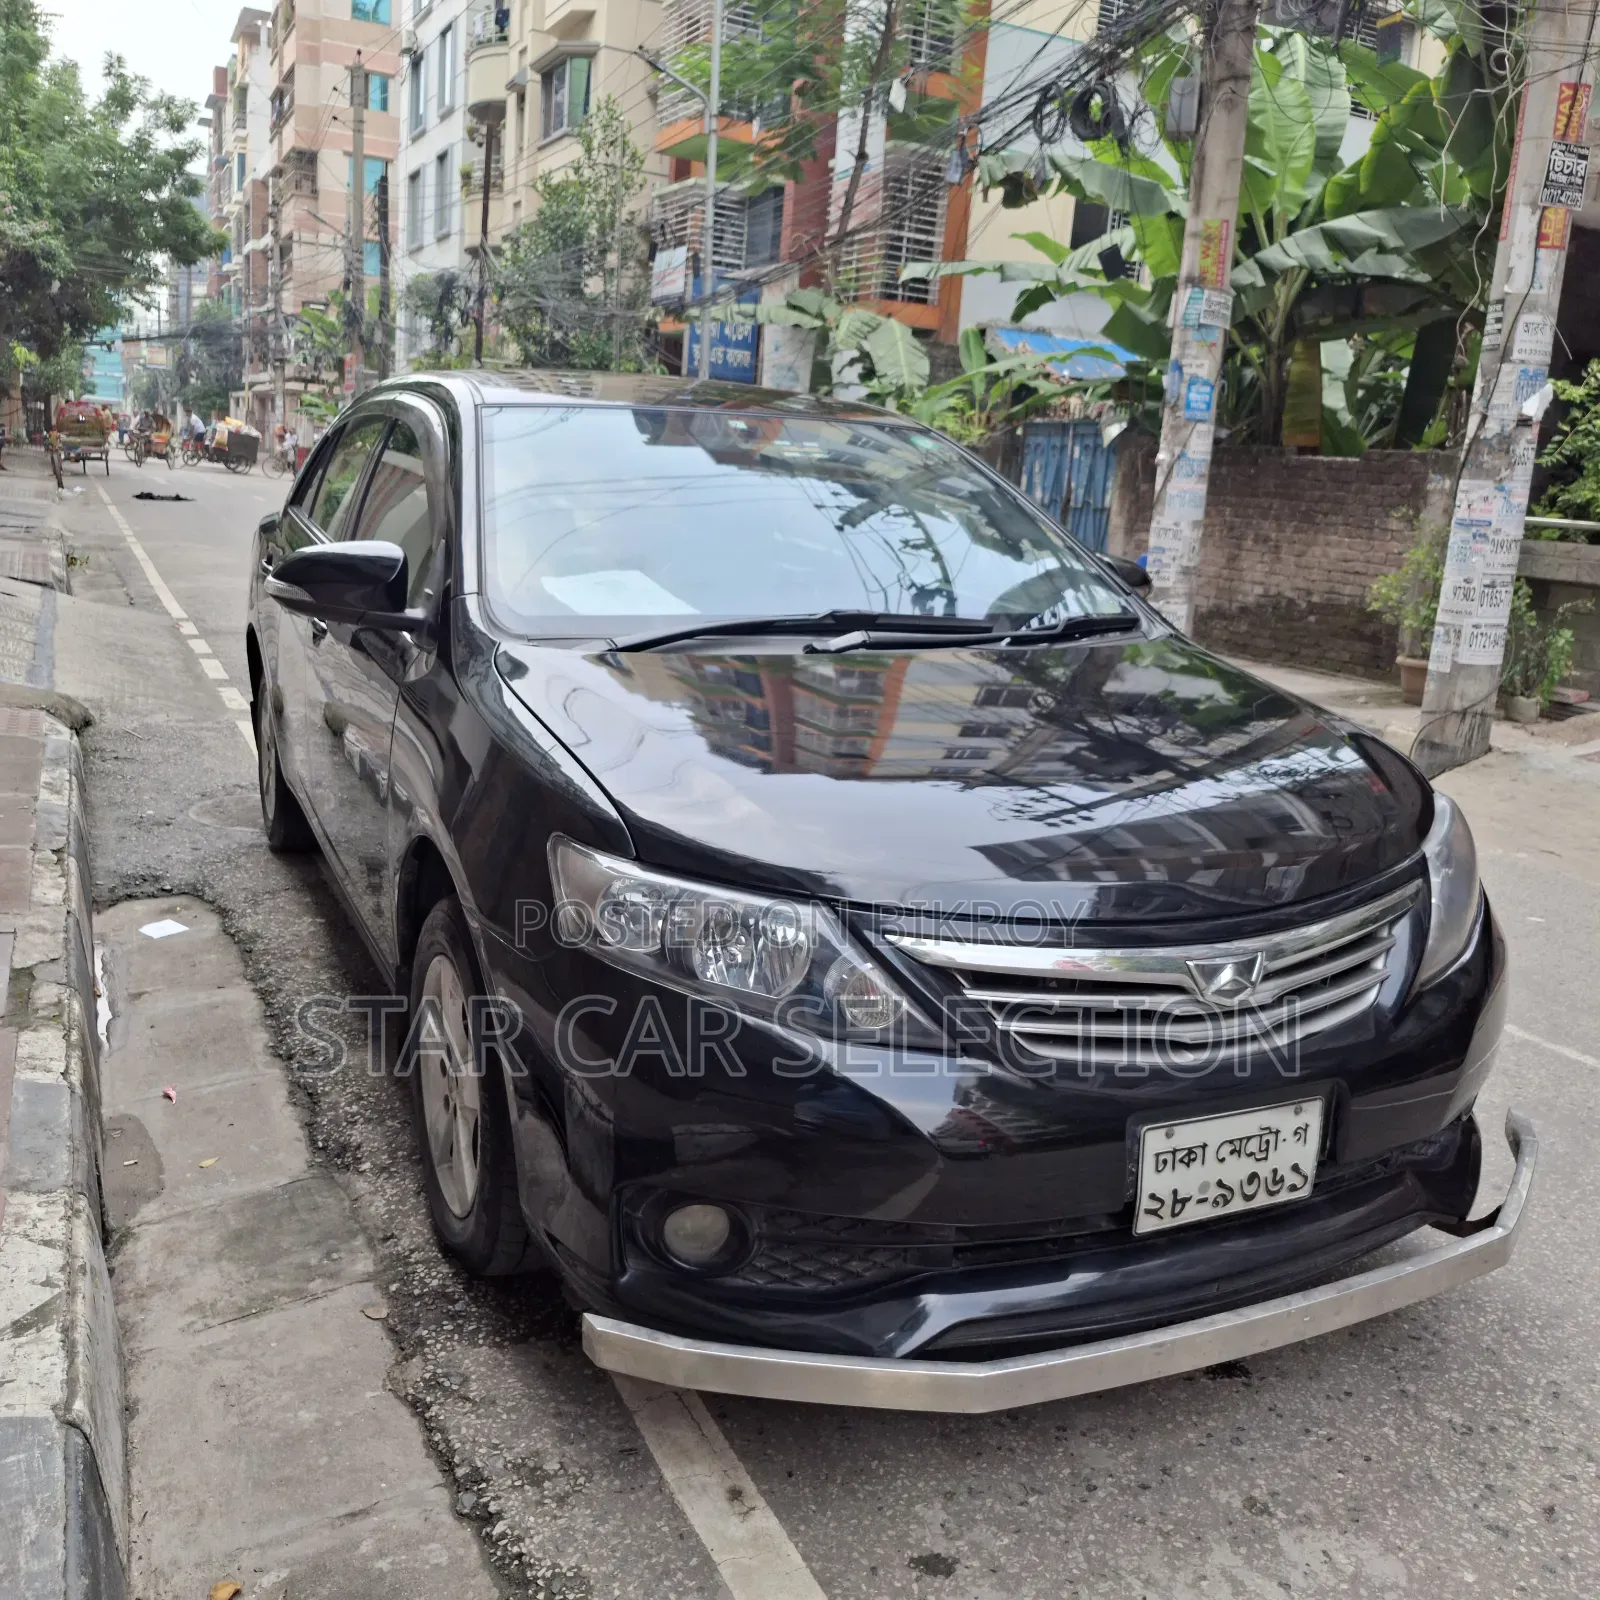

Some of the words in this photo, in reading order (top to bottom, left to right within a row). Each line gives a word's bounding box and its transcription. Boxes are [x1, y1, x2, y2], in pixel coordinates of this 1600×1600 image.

[1554, 84, 1574, 137] WAY
[1550, 150, 1587, 177] টিচার
[1153, 1142, 1208, 1173] ঢাকা
